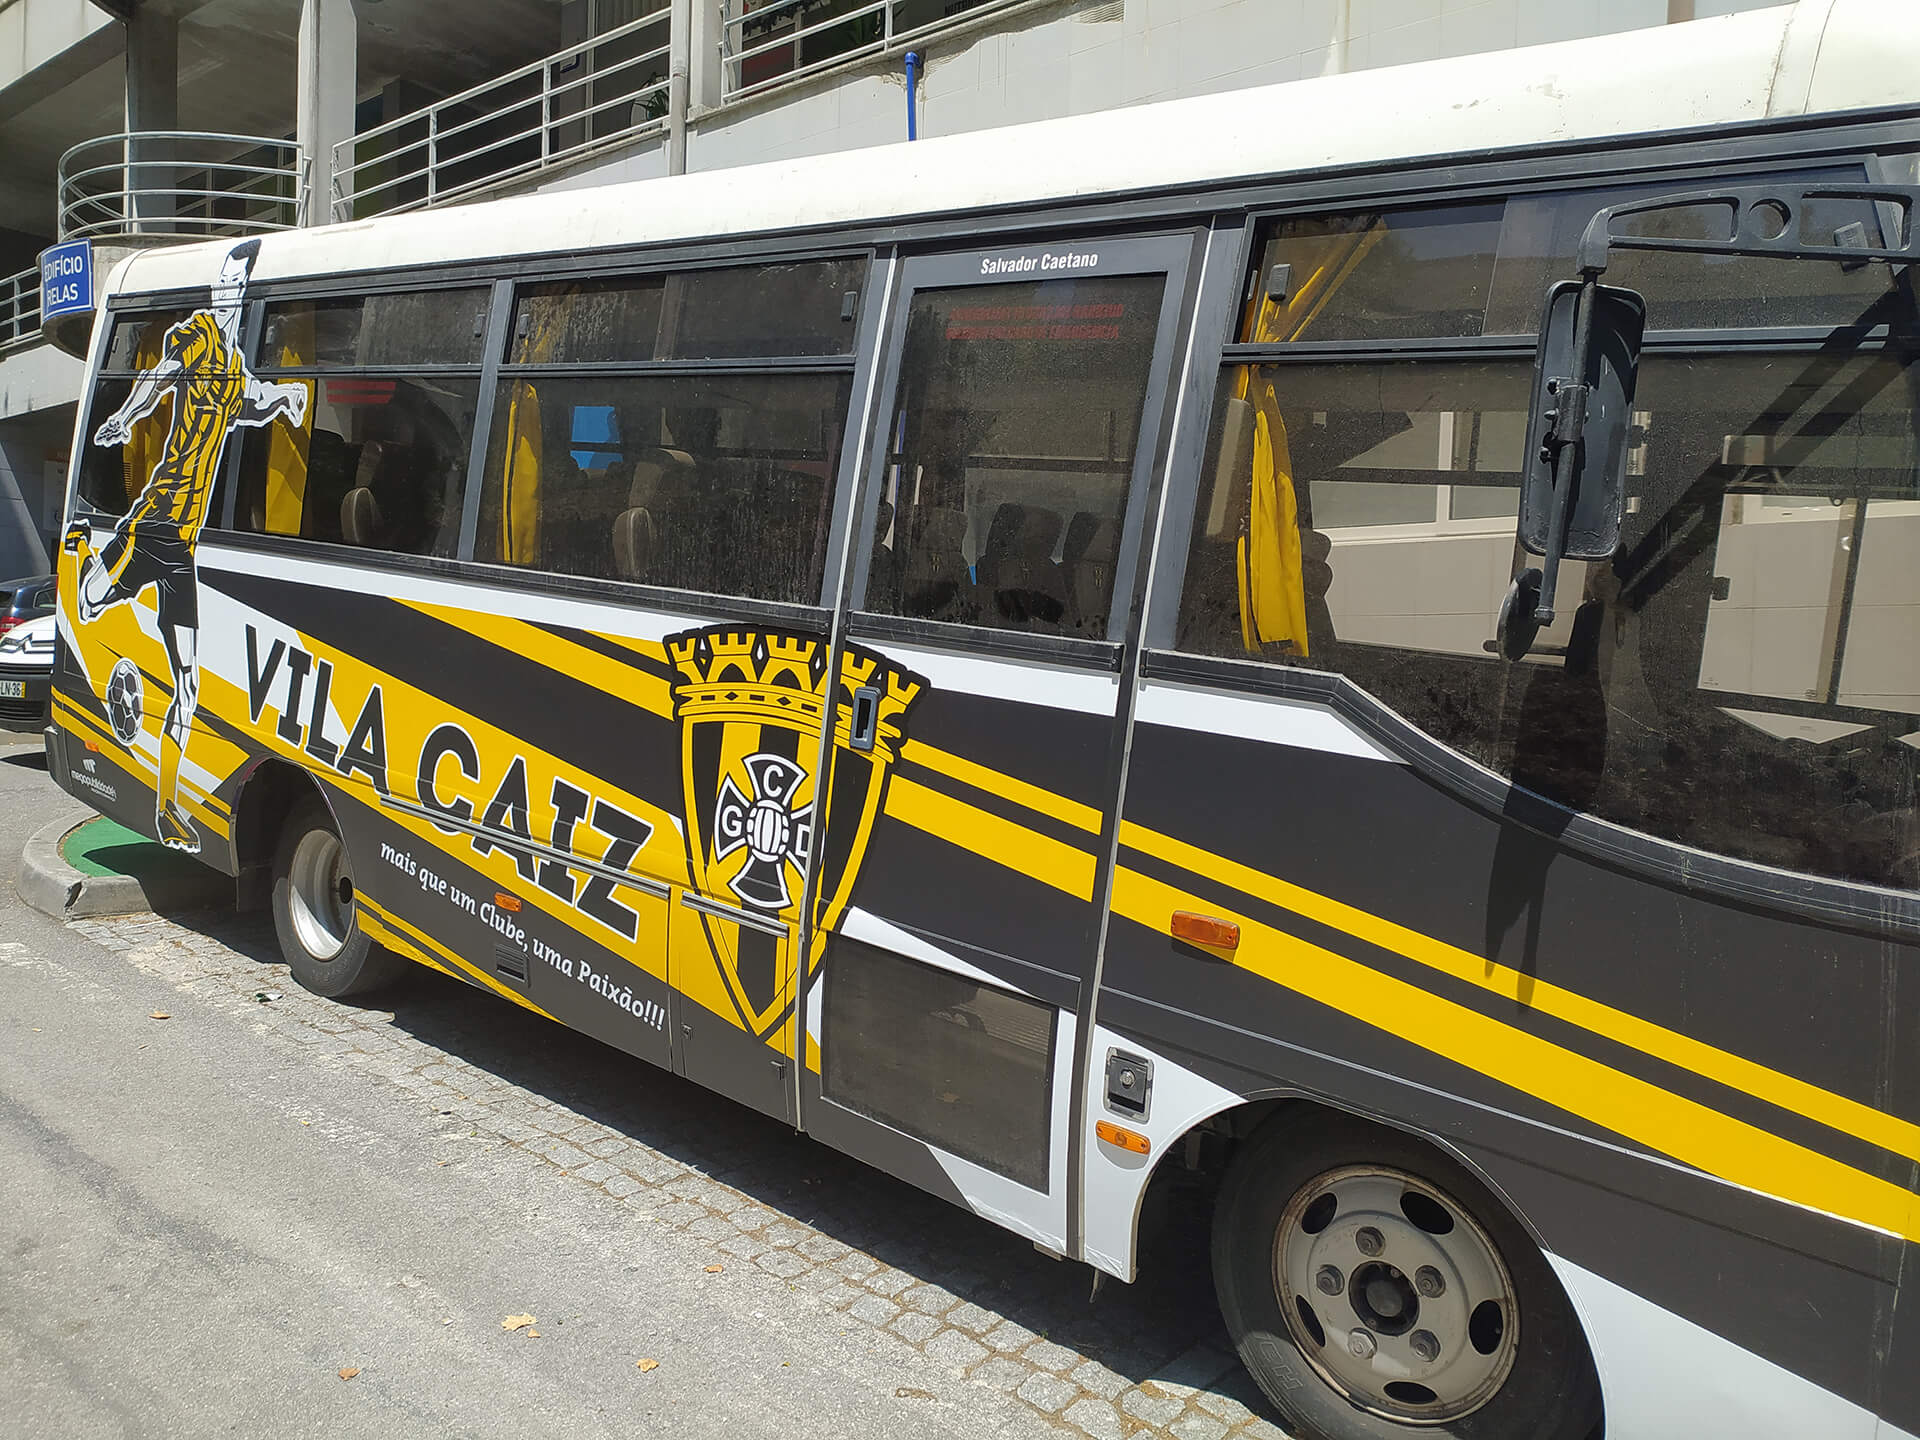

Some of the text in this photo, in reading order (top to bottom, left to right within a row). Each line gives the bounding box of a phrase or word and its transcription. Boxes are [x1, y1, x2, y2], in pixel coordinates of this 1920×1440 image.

[44, 254, 83, 282] EDIFÍCIO
[981, 252, 1099, 274] Salvador Caetano
[244, 622, 656, 944] VILA CAIZ
[762, 764, 785, 798] C
[721, 804, 743, 838] G
[380, 842, 666, 1032] mais que um Clube, uma Paixão!!!
